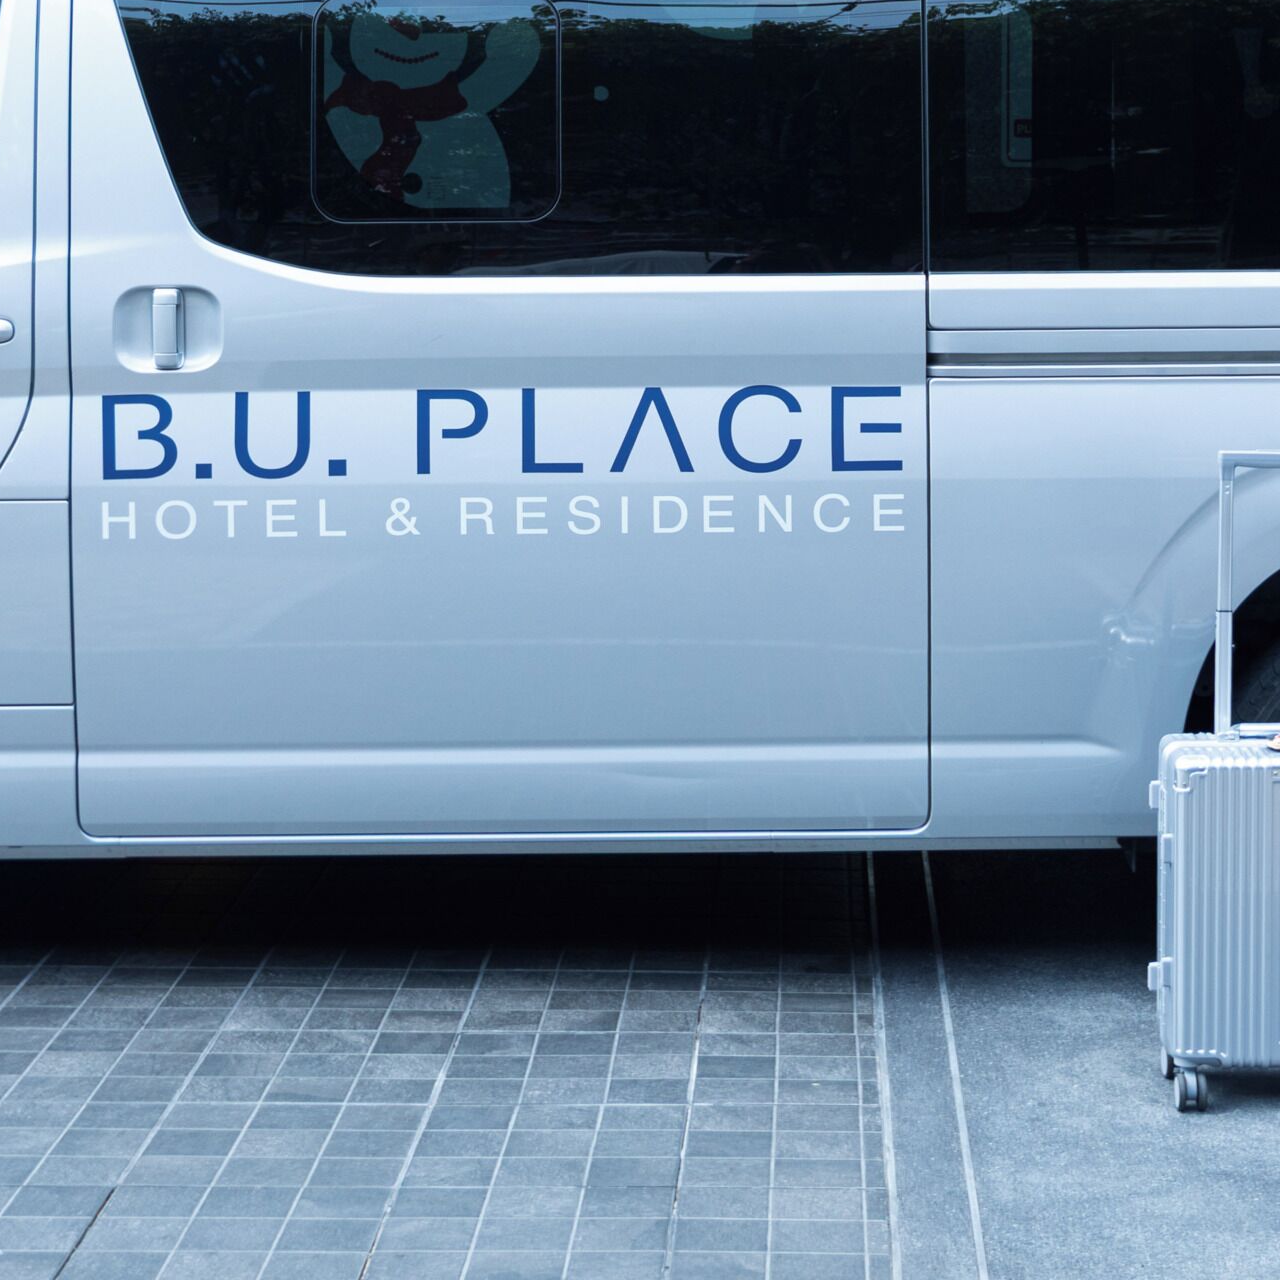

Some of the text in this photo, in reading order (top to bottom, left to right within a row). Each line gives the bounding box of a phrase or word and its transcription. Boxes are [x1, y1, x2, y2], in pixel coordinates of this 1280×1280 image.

[102, 384, 903, 481] B.U. PLACE
[102, 493, 905, 540] HOTEL & RESIDENCE
